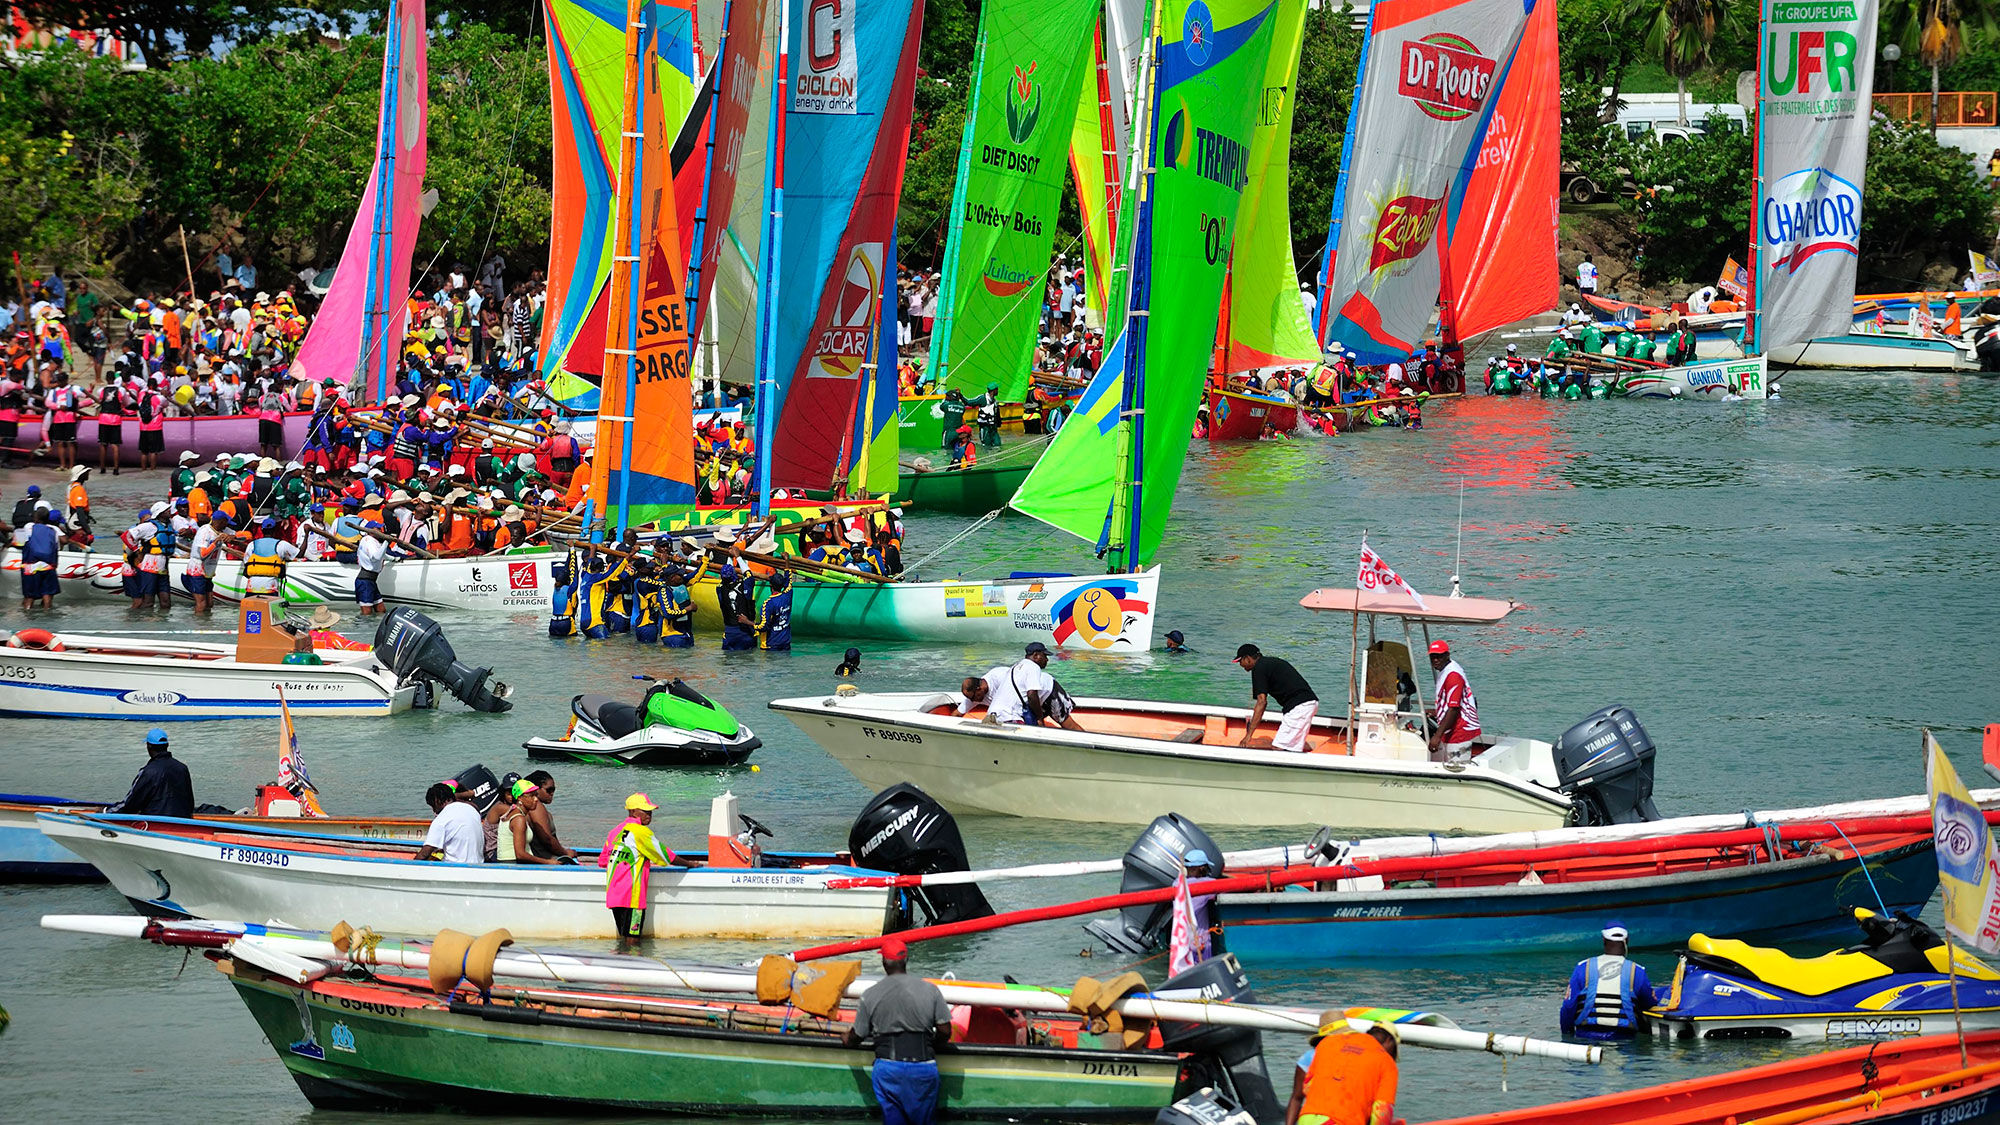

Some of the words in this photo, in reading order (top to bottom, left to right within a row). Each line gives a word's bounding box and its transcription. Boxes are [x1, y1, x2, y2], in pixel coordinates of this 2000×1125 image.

[1786, 7, 1827, 19] GROUPE
[1830, 6, 1853, 18] UFR
[1768, 31, 1857, 96] UFR
[1407, 47, 1434, 88] Dr
[1435, 53, 1490, 103] Roots
[796, 98, 825, 111] energy
[829, 98, 853, 110] drink
[982, 144, 1007, 168] DIET
[1013, 211, 1042, 236] Bois
[984, 257, 1036, 287] Julian's
[638, 304, 683, 339] SSE
[1687, 368, 1725, 386] CHANFLOR
[1728, 372, 1762, 391] UFR
[459, 583, 498, 592] uniross
[503, 598, 548, 606] D'EPARGNE
[1013, 612, 1050, 622] TRANSPORT
[1014, 621, 1053, 631] EUPHRASIE
[386, 621, 404, 647] YAMAHA
[157, 692, 173, 704] 630
[862, 727, 876, 738] FF
[879, 729, 923, 744] 890599
[1584, 732, 1618, 753] YAMAHA
[472, 781, 491, 797] UDE
[860, 804, 900, 858] MERCURY
[1152, 824, 1186, 854] YAMAHA
[220, 847, 234, 860] FF
[238, 849, 290, 867] 890494D
[731, 876, 741, 884] LA
[743, 876, 769, 884] PAROLE
[772, 876, 784, 884] EST
[786, 876, 805, 884] LIBRE
[1333, 906, 1403, 918] SAINT-PIERRE
[1082, 1062, 1140, 1077] DIAPA
[1940, 1096, 1989, 1125] 890237
